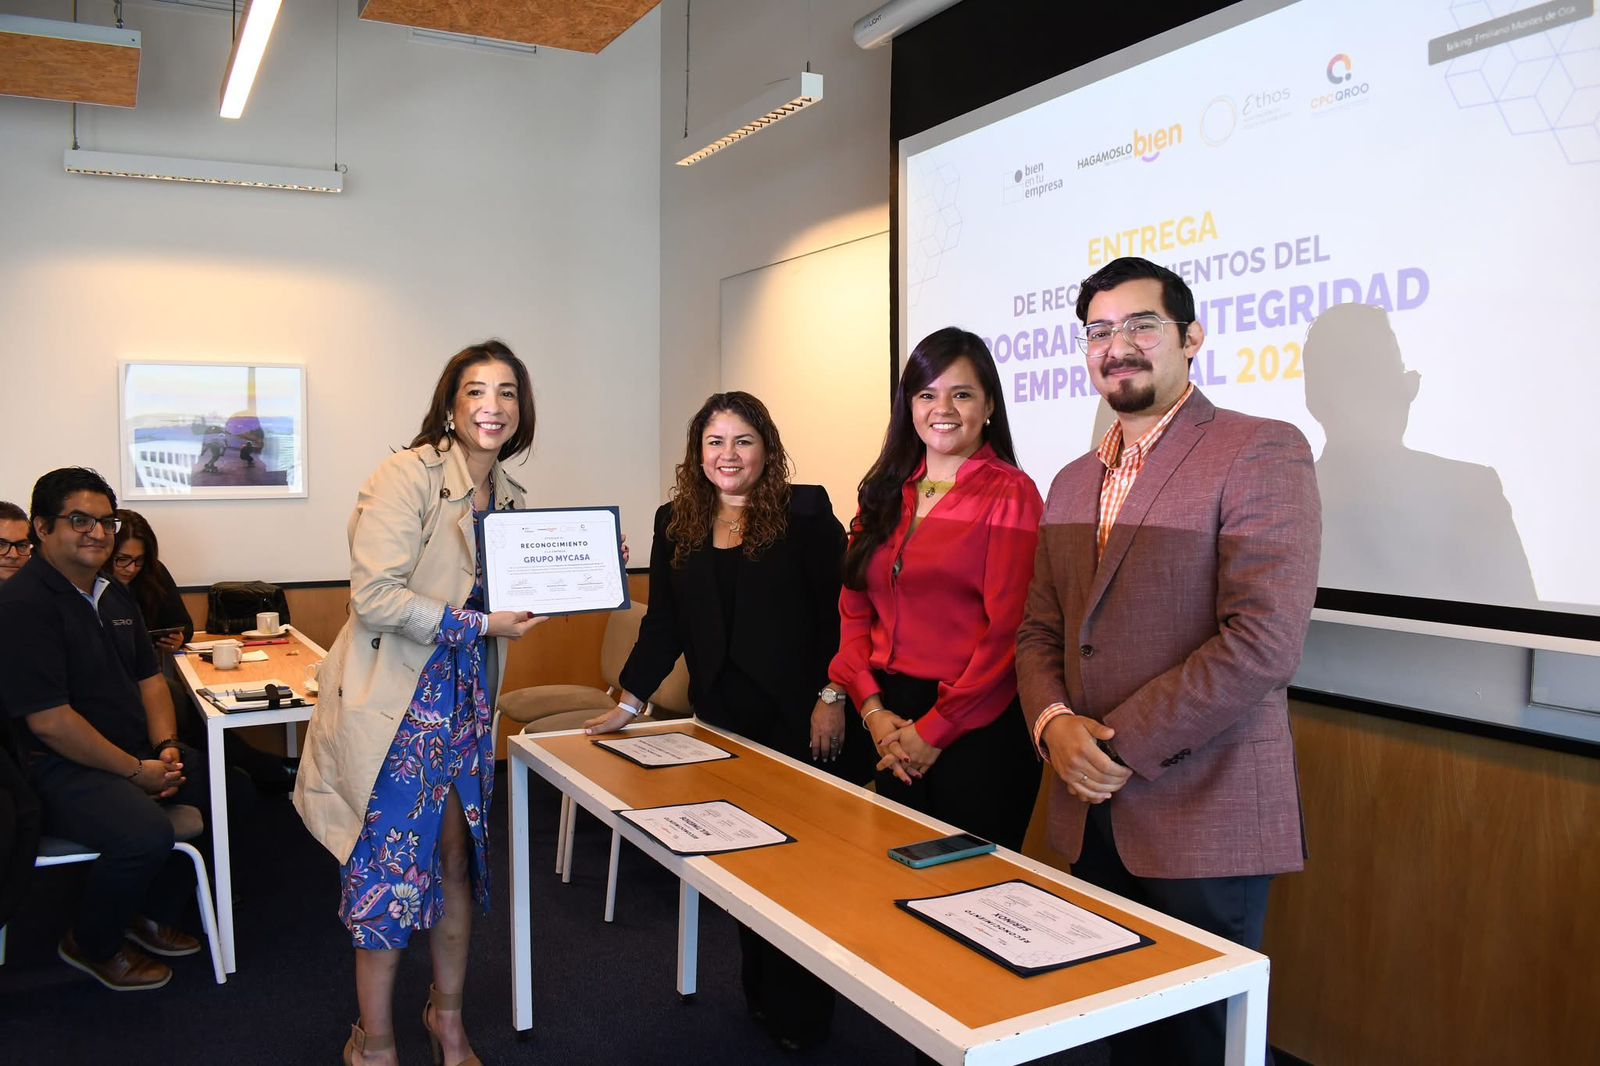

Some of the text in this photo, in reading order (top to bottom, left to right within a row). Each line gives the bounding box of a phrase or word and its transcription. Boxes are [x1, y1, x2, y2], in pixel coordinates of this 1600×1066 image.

[1242, 88, 1291, 116] Ethos
[1077, 122, 1184, 170] HAGAMOSLO bien
[1024, 162, 1044, 177] bien
[1024, 177, 1035, 188] en
[1024, 179, 1063, 198] empresa
[1087, 210, 1220, 266] ENTREGA
[1013, 292, 1037, 317] DE
[1275, 235, 1330, 270] DEL
[1200, 267, 1430, 337] TEGRIDAD
[1236, 341, 1304, 384] 202
[520, 541, 588, 549] RECONOCIMIENTO
[523, 554, 590, 564] GRUPO MYCASA
[965, 909, 1031, 944] RECONOCIMIENTO
